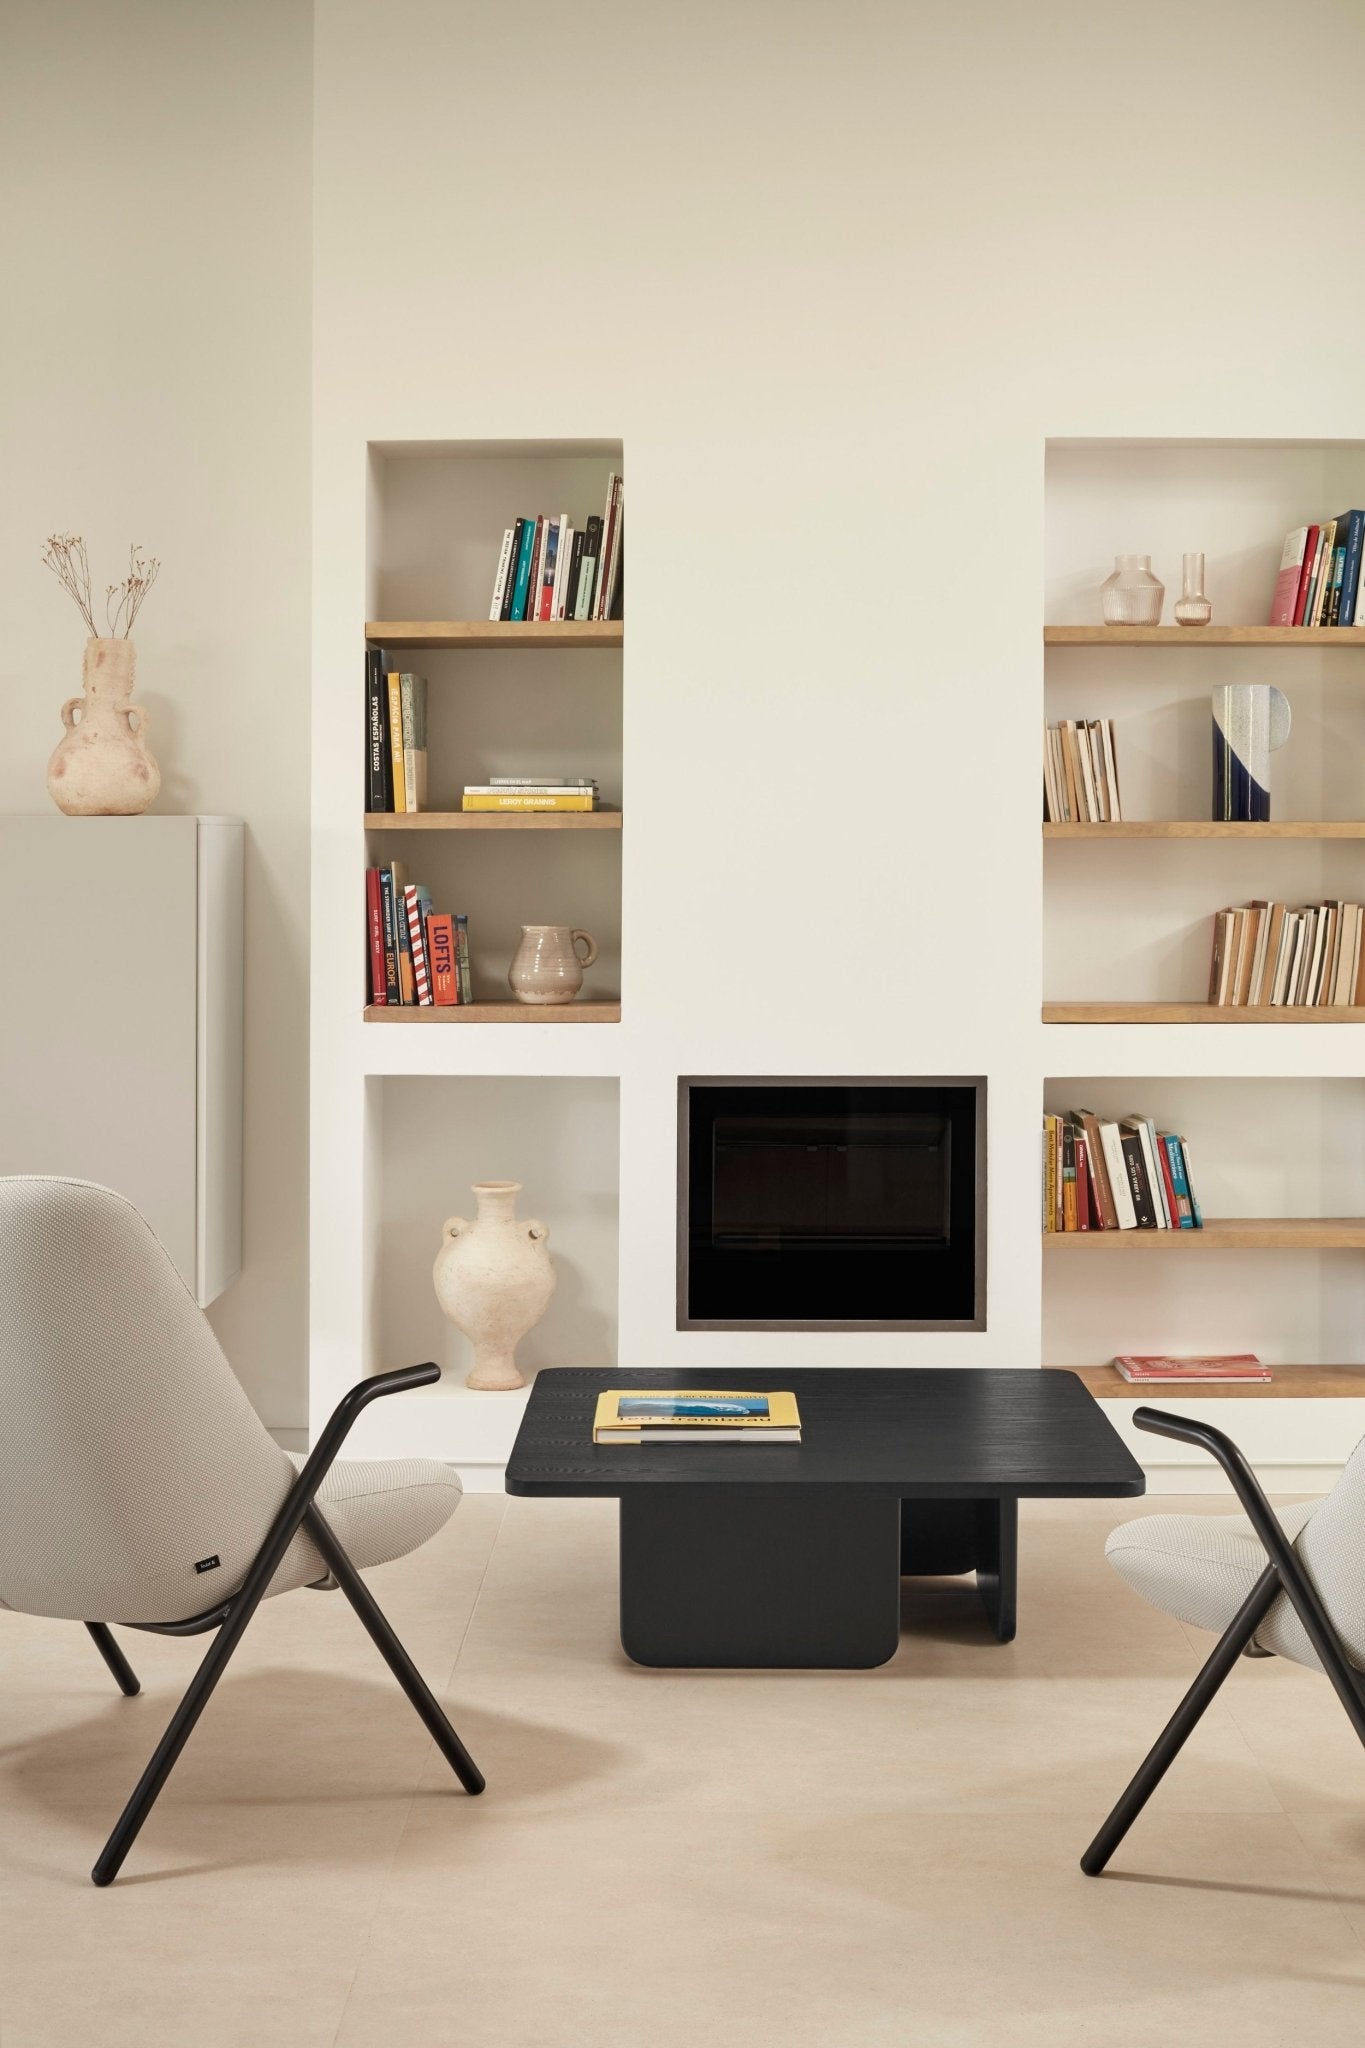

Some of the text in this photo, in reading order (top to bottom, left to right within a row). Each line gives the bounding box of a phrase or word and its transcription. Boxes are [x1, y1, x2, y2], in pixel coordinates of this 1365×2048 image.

[371, 696, 379, 735] ESPAÑOLAS
[499, 798, 556, 806] LEROY GRANNIS
[399, 920, 407, 940] JULIO
[433, 925, 451, 974] LOFTS
[386, 952, 397, 987] EUROPE
[1048, 1184, 1056, 1216] Apartments
